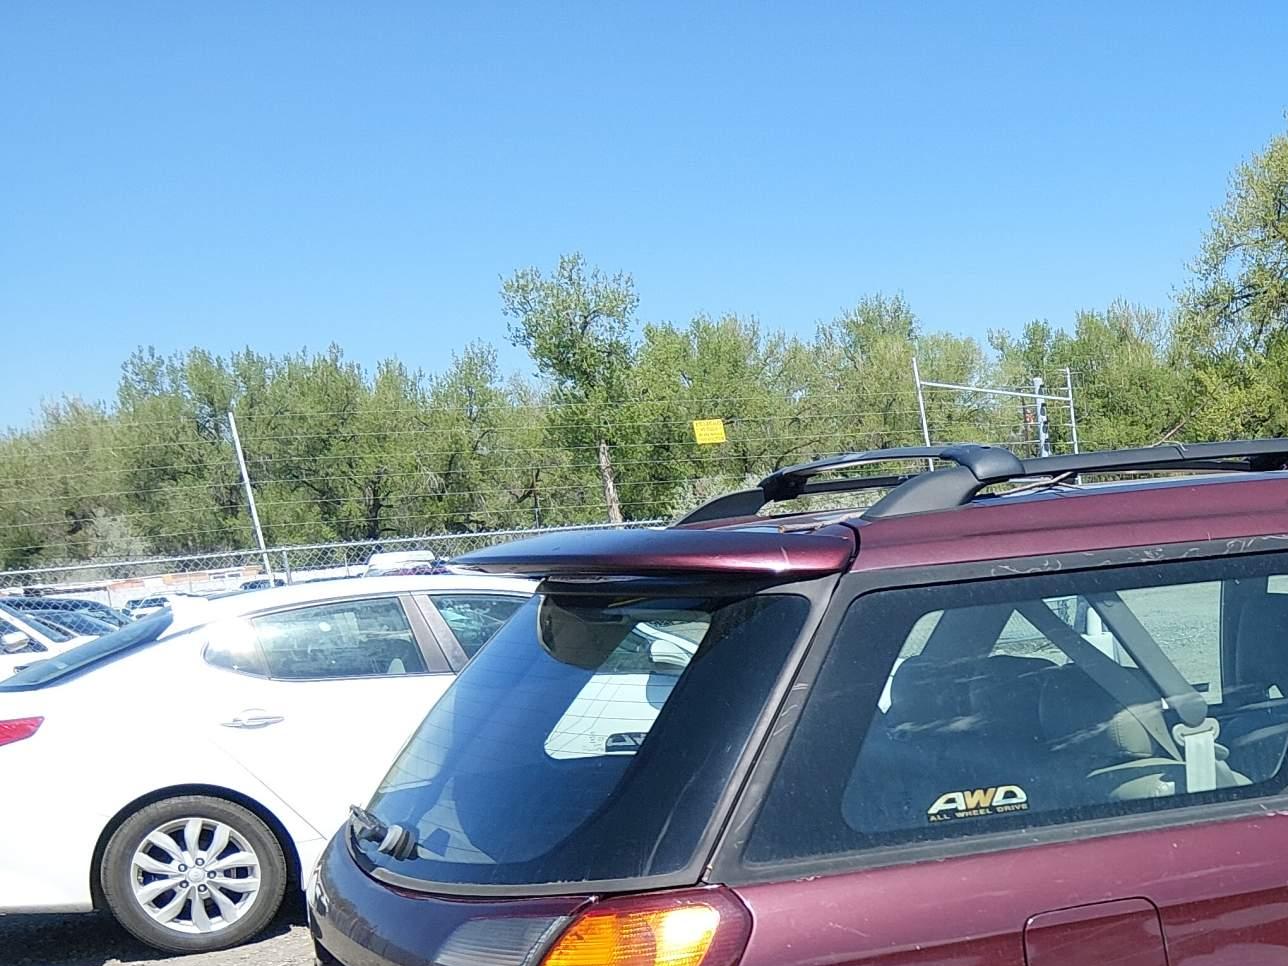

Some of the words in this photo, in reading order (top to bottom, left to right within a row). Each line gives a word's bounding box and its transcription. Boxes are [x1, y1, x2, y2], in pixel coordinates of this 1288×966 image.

[927, 784, 1028, 815] AWD
[955, 809, 993, 818] WHEEL
[996, 803, 1029, 813] DRIVE
